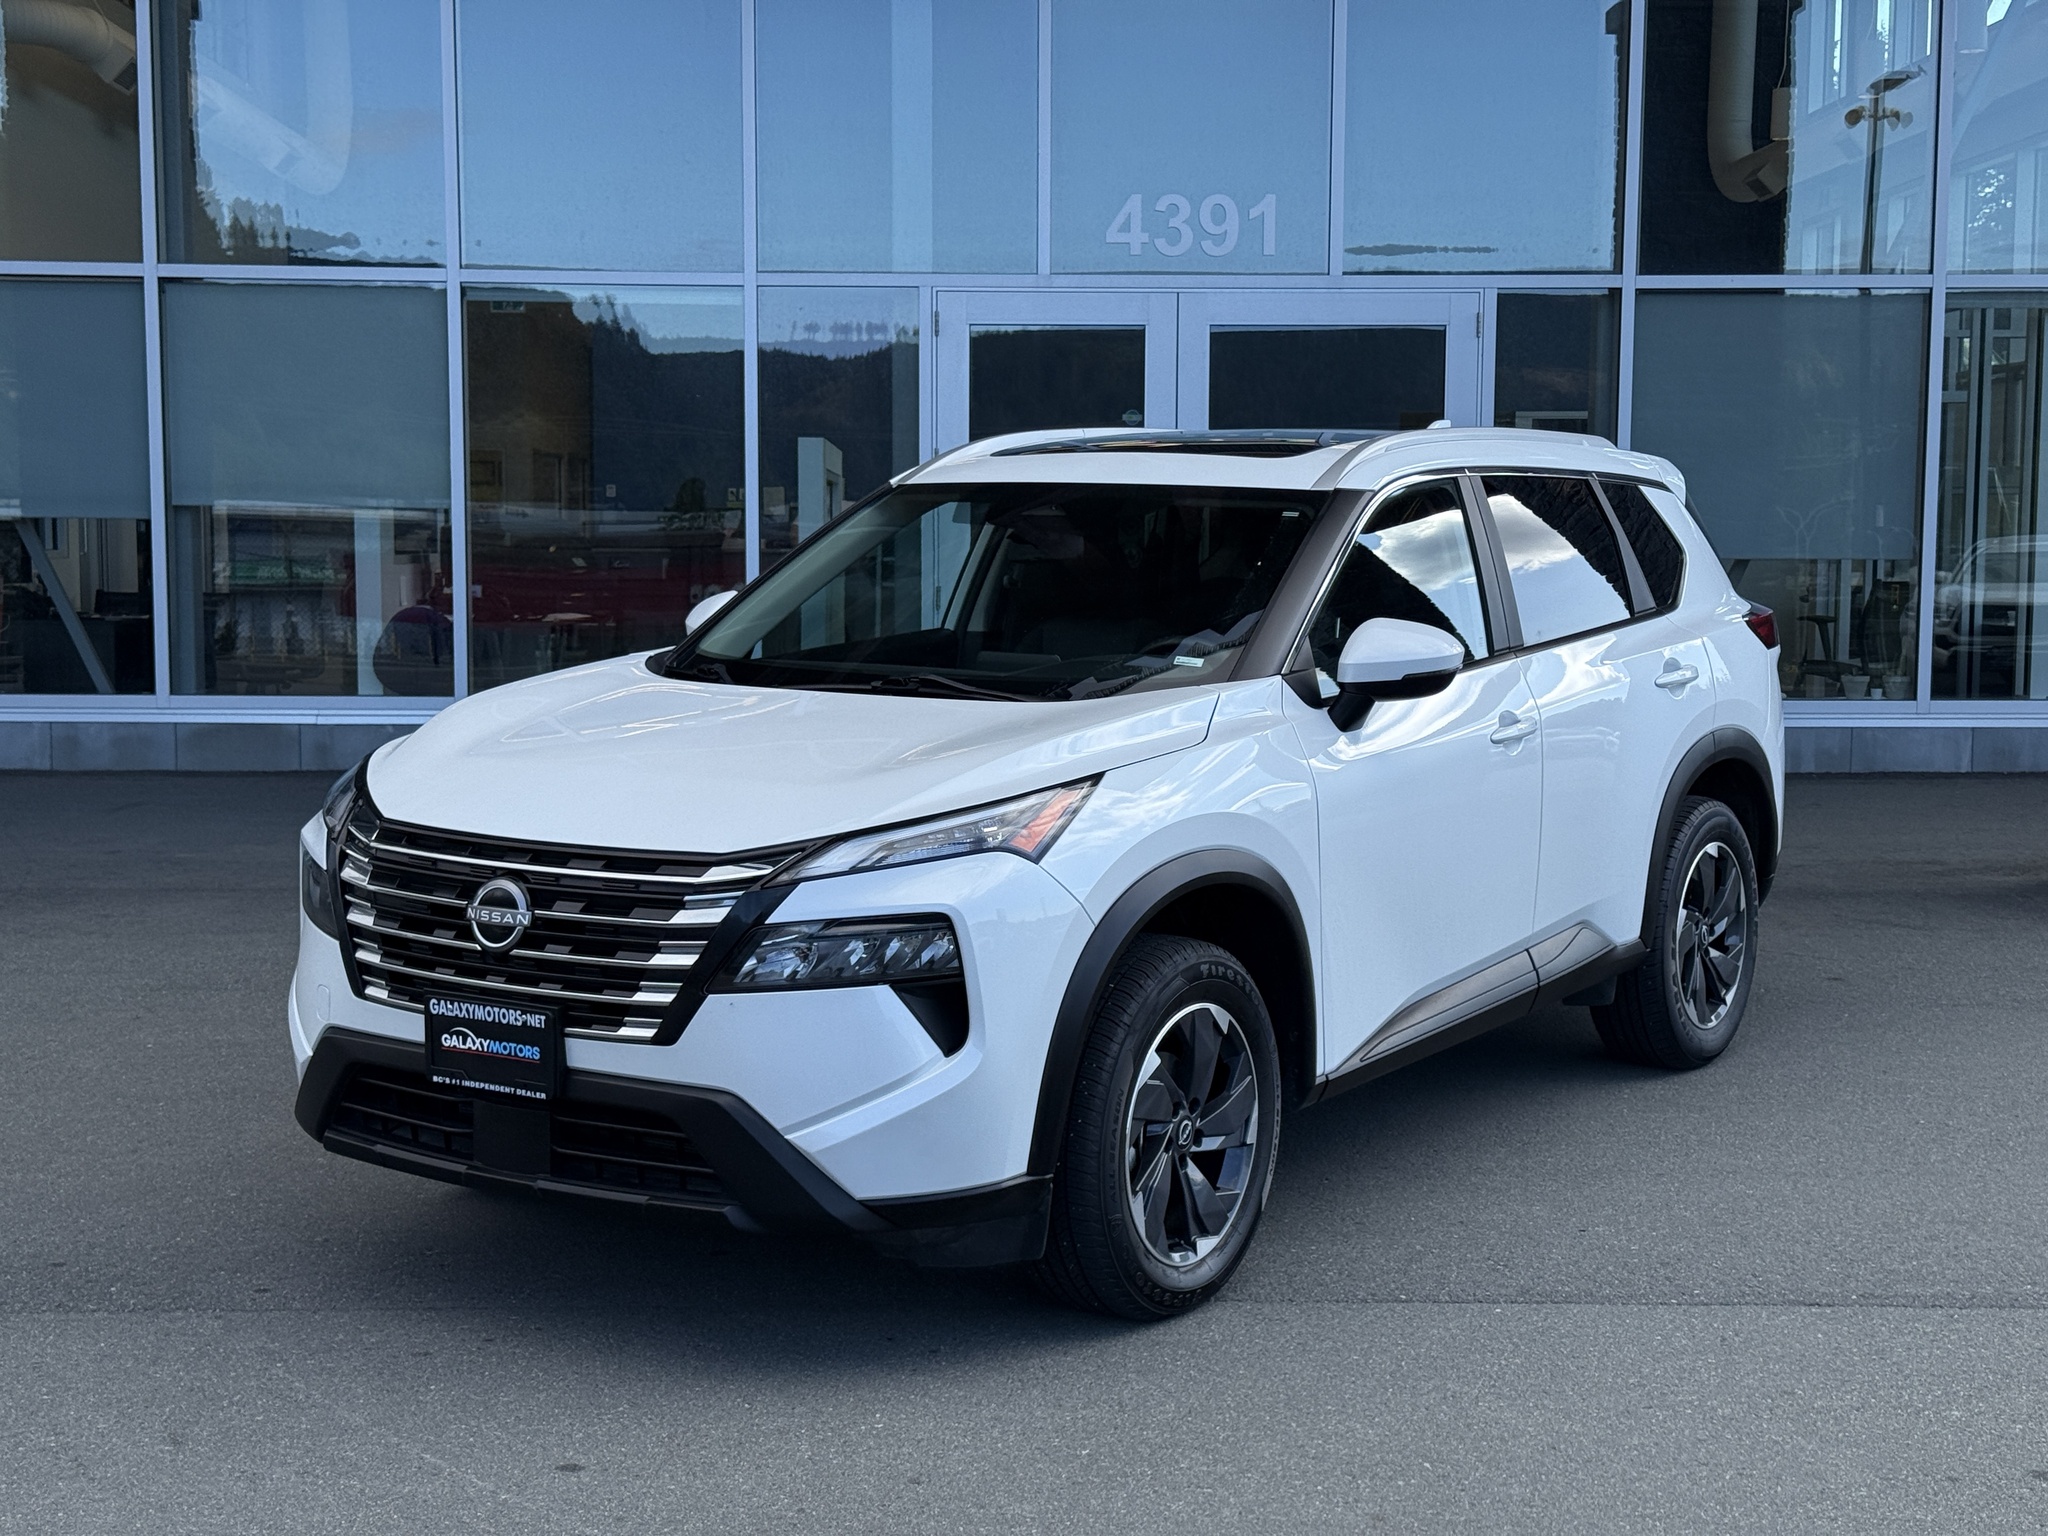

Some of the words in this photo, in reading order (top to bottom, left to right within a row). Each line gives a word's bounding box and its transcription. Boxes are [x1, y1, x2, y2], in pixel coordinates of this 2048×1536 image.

[1105, 193, 1277, 258] 4391
[466, 907, 530, 925] NISSAN
[432, 1075, 451, 1084] BC'S
[461, 1079, 515, 1094] INDEPENDENT
[516, 1087, 547, 1100] DEALER
